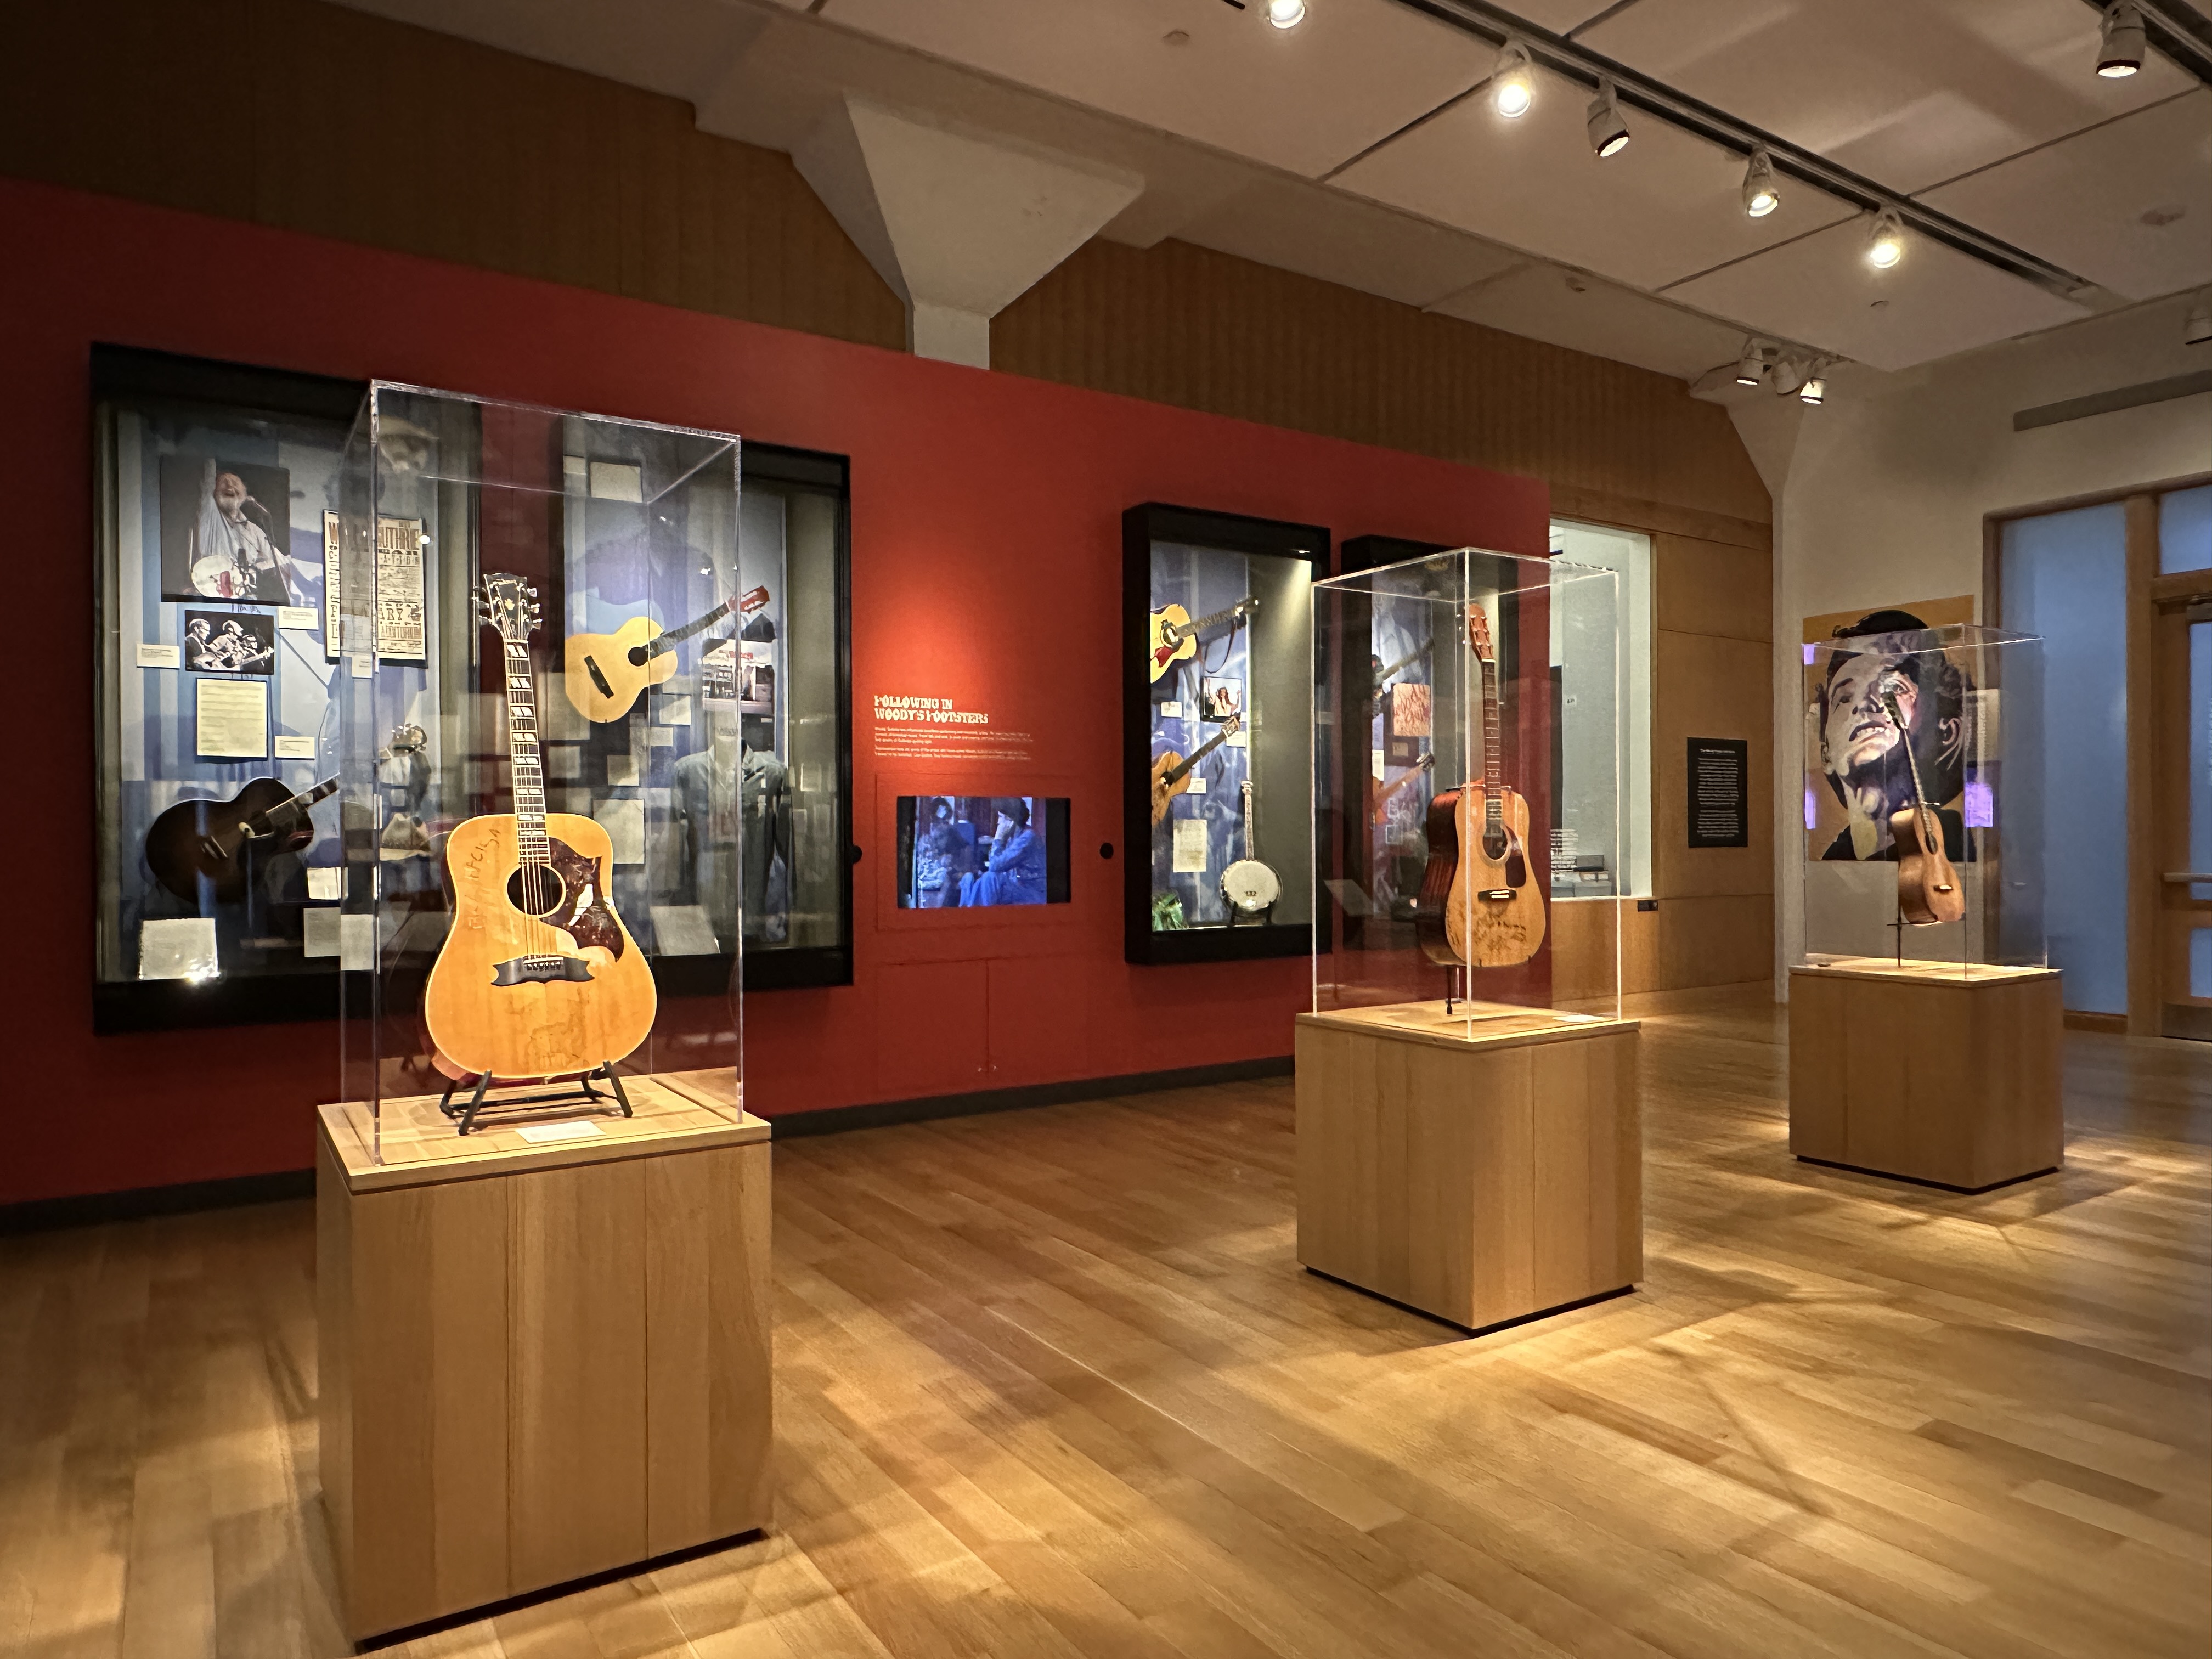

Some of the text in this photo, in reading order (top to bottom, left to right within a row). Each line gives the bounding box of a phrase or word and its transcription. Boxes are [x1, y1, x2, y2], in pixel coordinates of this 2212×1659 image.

[874, 695, 953, 710] FOLLOWING IN
[926, 710, 988, 724] FOOTSTEPS
